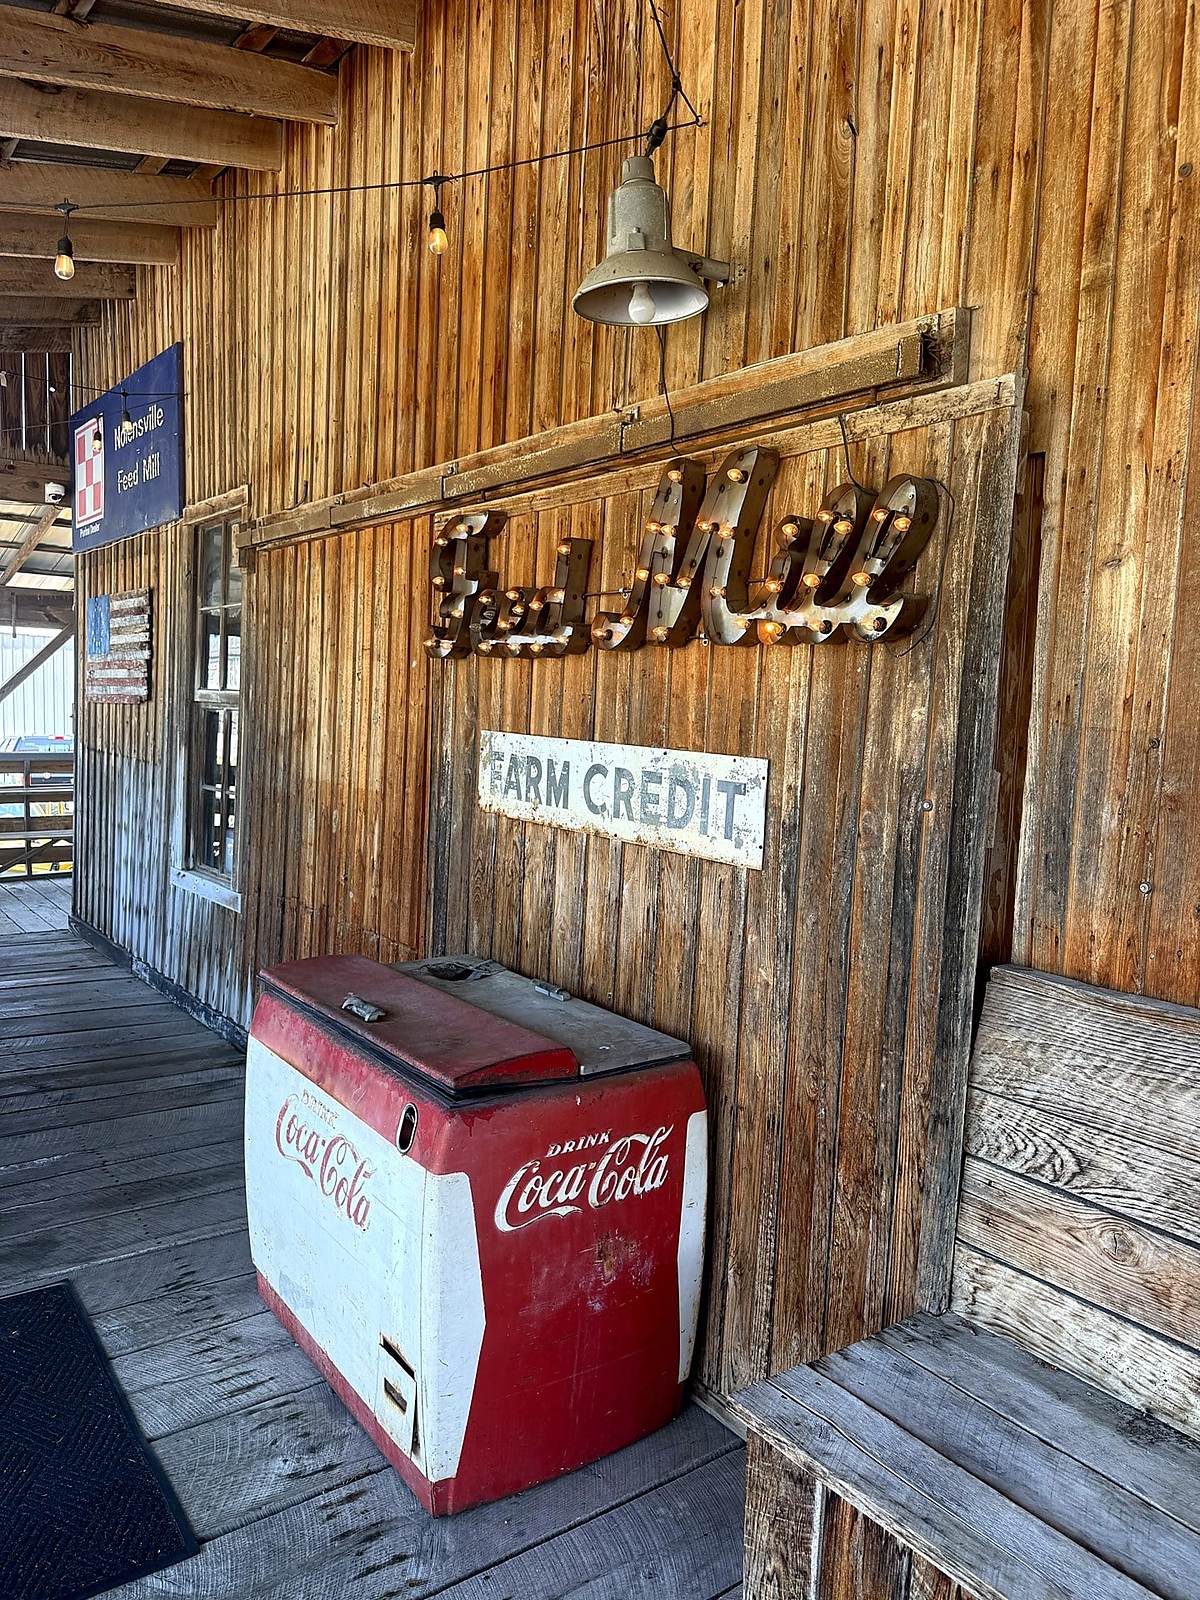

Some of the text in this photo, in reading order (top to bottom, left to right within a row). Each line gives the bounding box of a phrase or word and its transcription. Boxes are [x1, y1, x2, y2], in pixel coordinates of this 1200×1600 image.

[117, 452, 160, 494] Feed Mill
[424, 445, 939, 659] Feed Mill
[490, 750, 747, 840] FARM CREDIT
[300, 1089, 340, 1129] DRINK
[545, 1128, 613, 1158] DRINK
[494, 1123, 674, 1233] Coca-Cola
